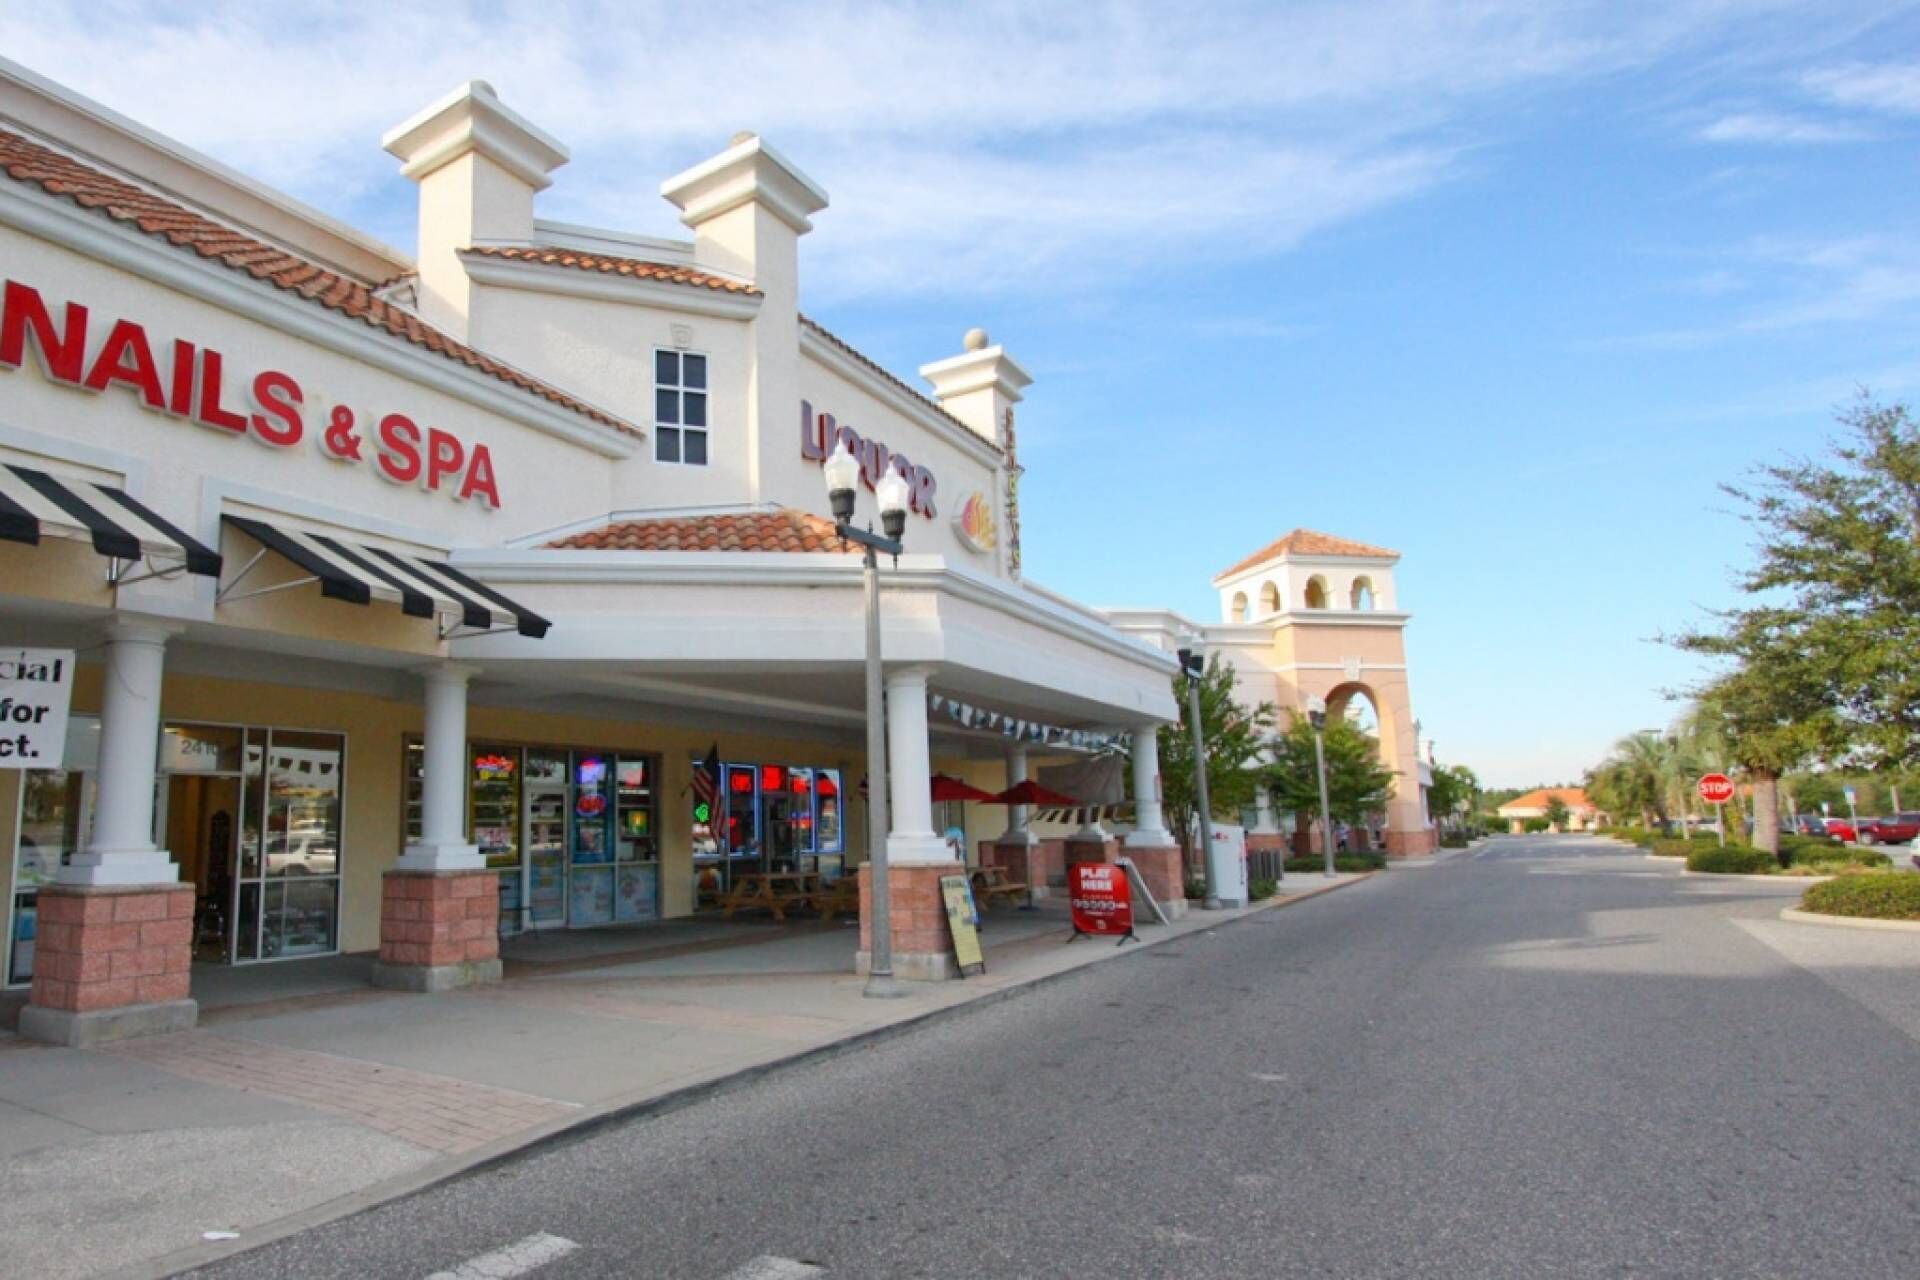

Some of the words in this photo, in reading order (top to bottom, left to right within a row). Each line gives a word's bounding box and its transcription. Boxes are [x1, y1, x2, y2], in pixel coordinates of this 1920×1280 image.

[0, 280, 304, 447] NAILS
[323, 405, 363, 461] &
[377, 414, 501, 510] SPA
[1700, 782, 1731, 793] STOP
[1080, 867, 1110, 879] PLAY
